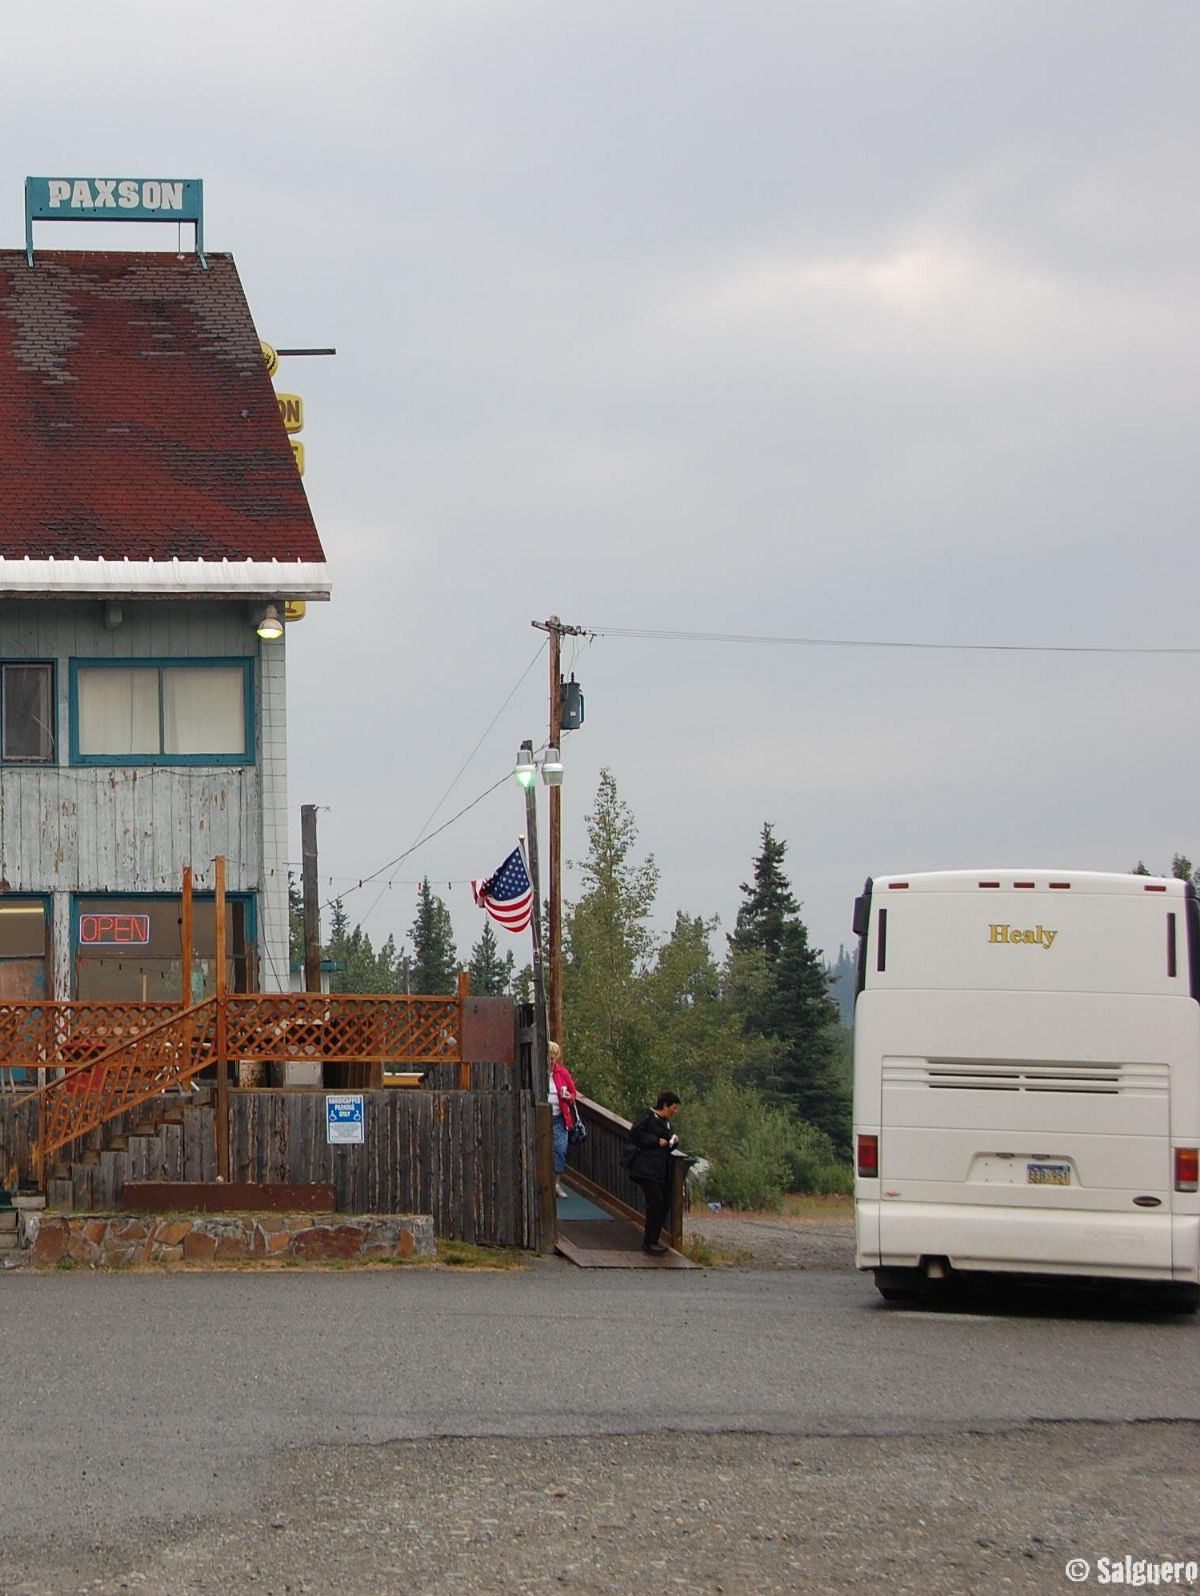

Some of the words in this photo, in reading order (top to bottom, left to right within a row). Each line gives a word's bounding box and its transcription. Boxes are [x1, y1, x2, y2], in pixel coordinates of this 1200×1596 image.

[48, 179, 184, 210] PAXSON
[82, 915, 147, 942] OPEN
[987, 923, 1058, 950] Healy
